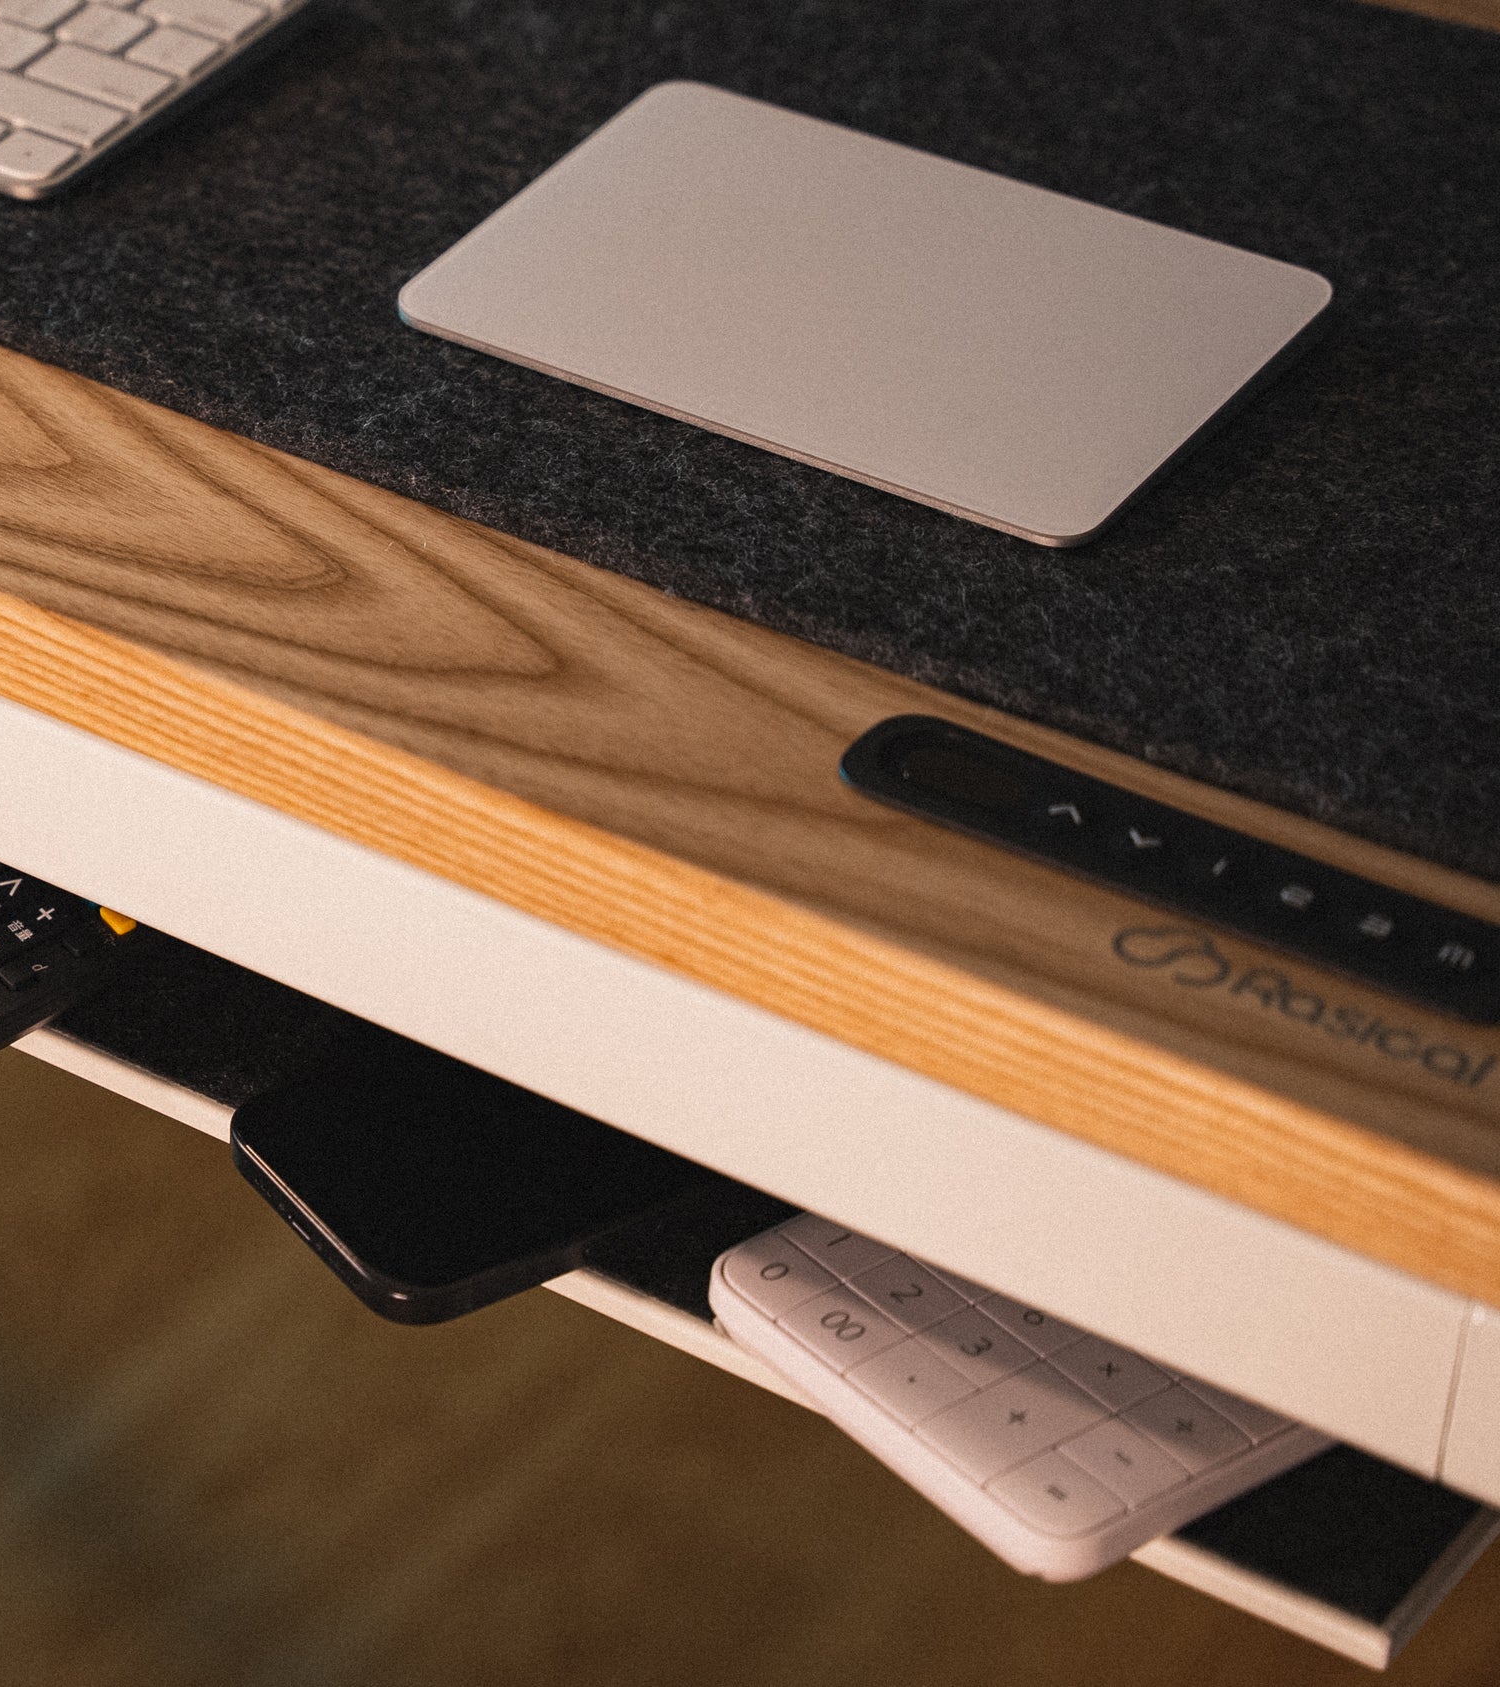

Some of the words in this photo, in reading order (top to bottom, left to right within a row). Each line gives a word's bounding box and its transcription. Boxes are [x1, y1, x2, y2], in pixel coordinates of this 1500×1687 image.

[7, 920, 34, 942] 音量
[31, 964, 49, 973] d
[760, 1262, 789, 1281] 0
[890, 1283, 923, 1304] 2
[820, 1310, 866, 1342] 00
[960, 1337, 993, 1357] 3
